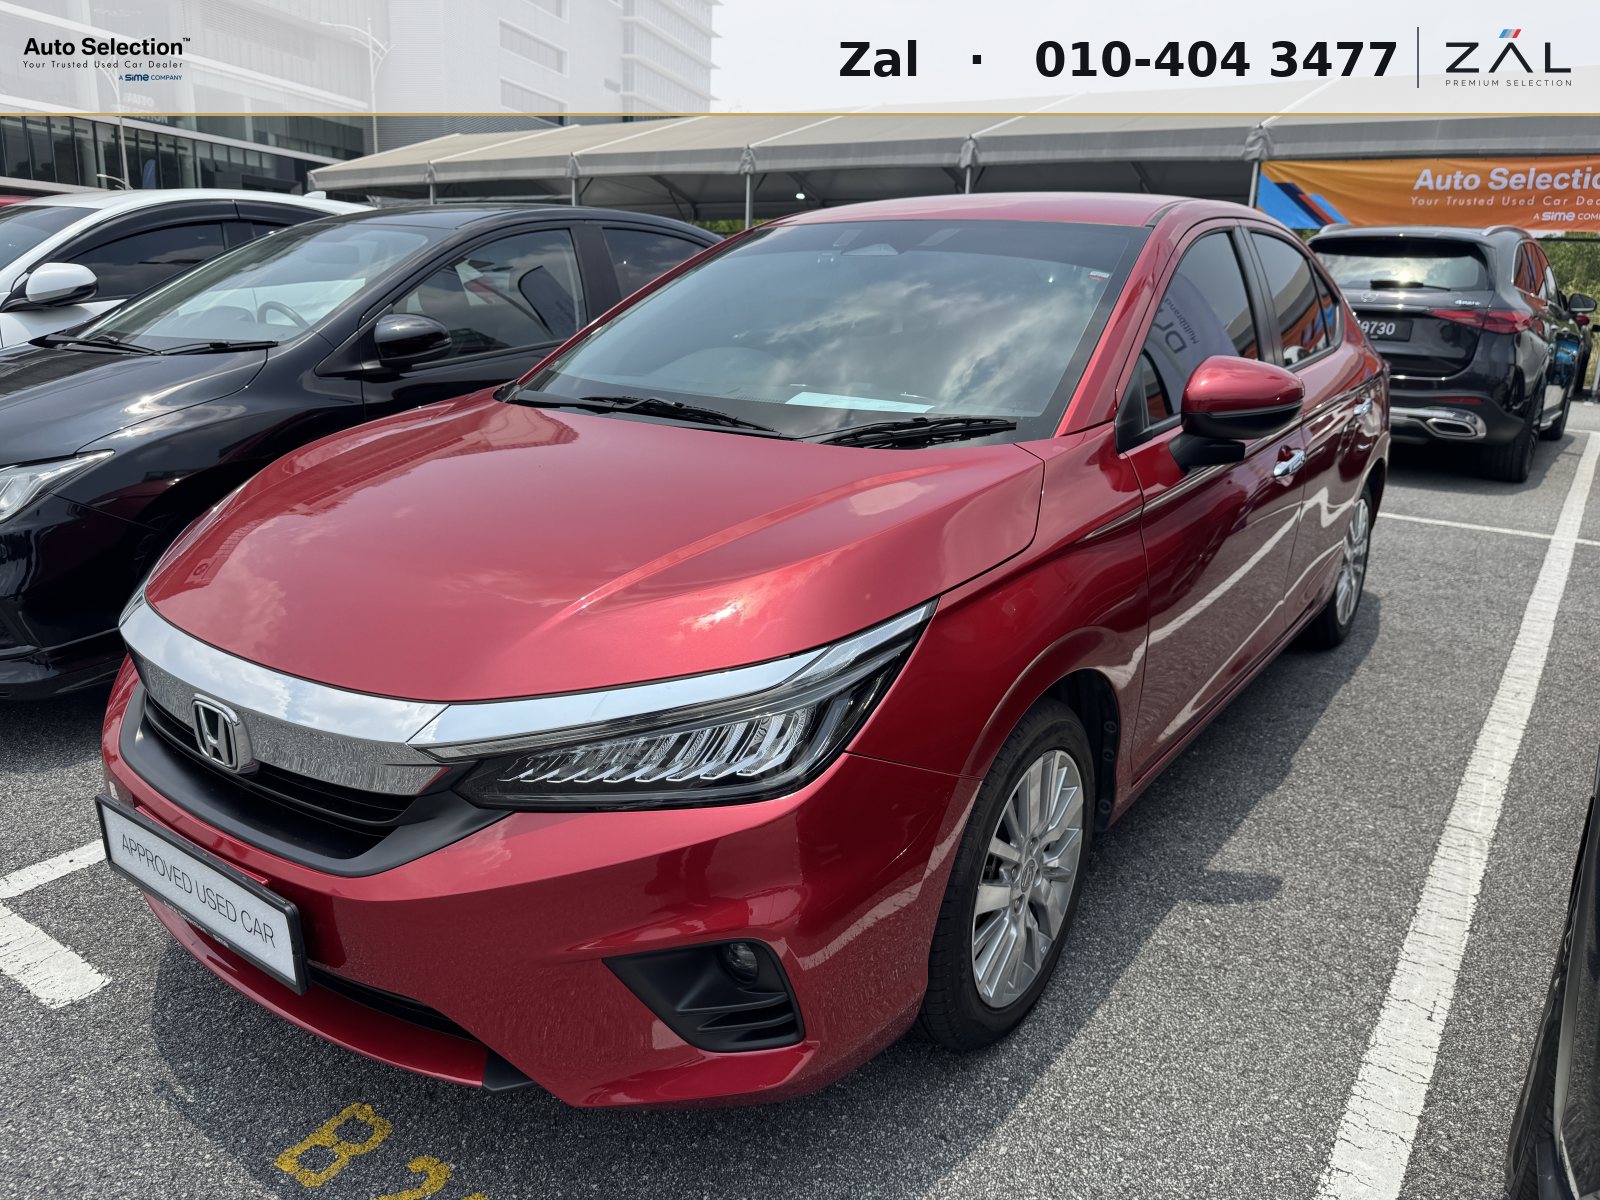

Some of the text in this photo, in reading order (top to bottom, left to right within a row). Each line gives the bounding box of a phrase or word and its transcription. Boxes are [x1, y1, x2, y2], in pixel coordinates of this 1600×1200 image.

[1413, 168, 1482, 191] Auto
[1410, 195, 1440, 207] Your
[1446, 195, 1496, 207] Trusted
[1502, 195, 1536, 207] Used
[1542, 195, 1569, 207] Car
[1532, 213, 1540, 221] A
[121, 833, 193, 894] APPROVED
[195, 879, 238, 923] USED
[240, 910, 276, 949] CAR
